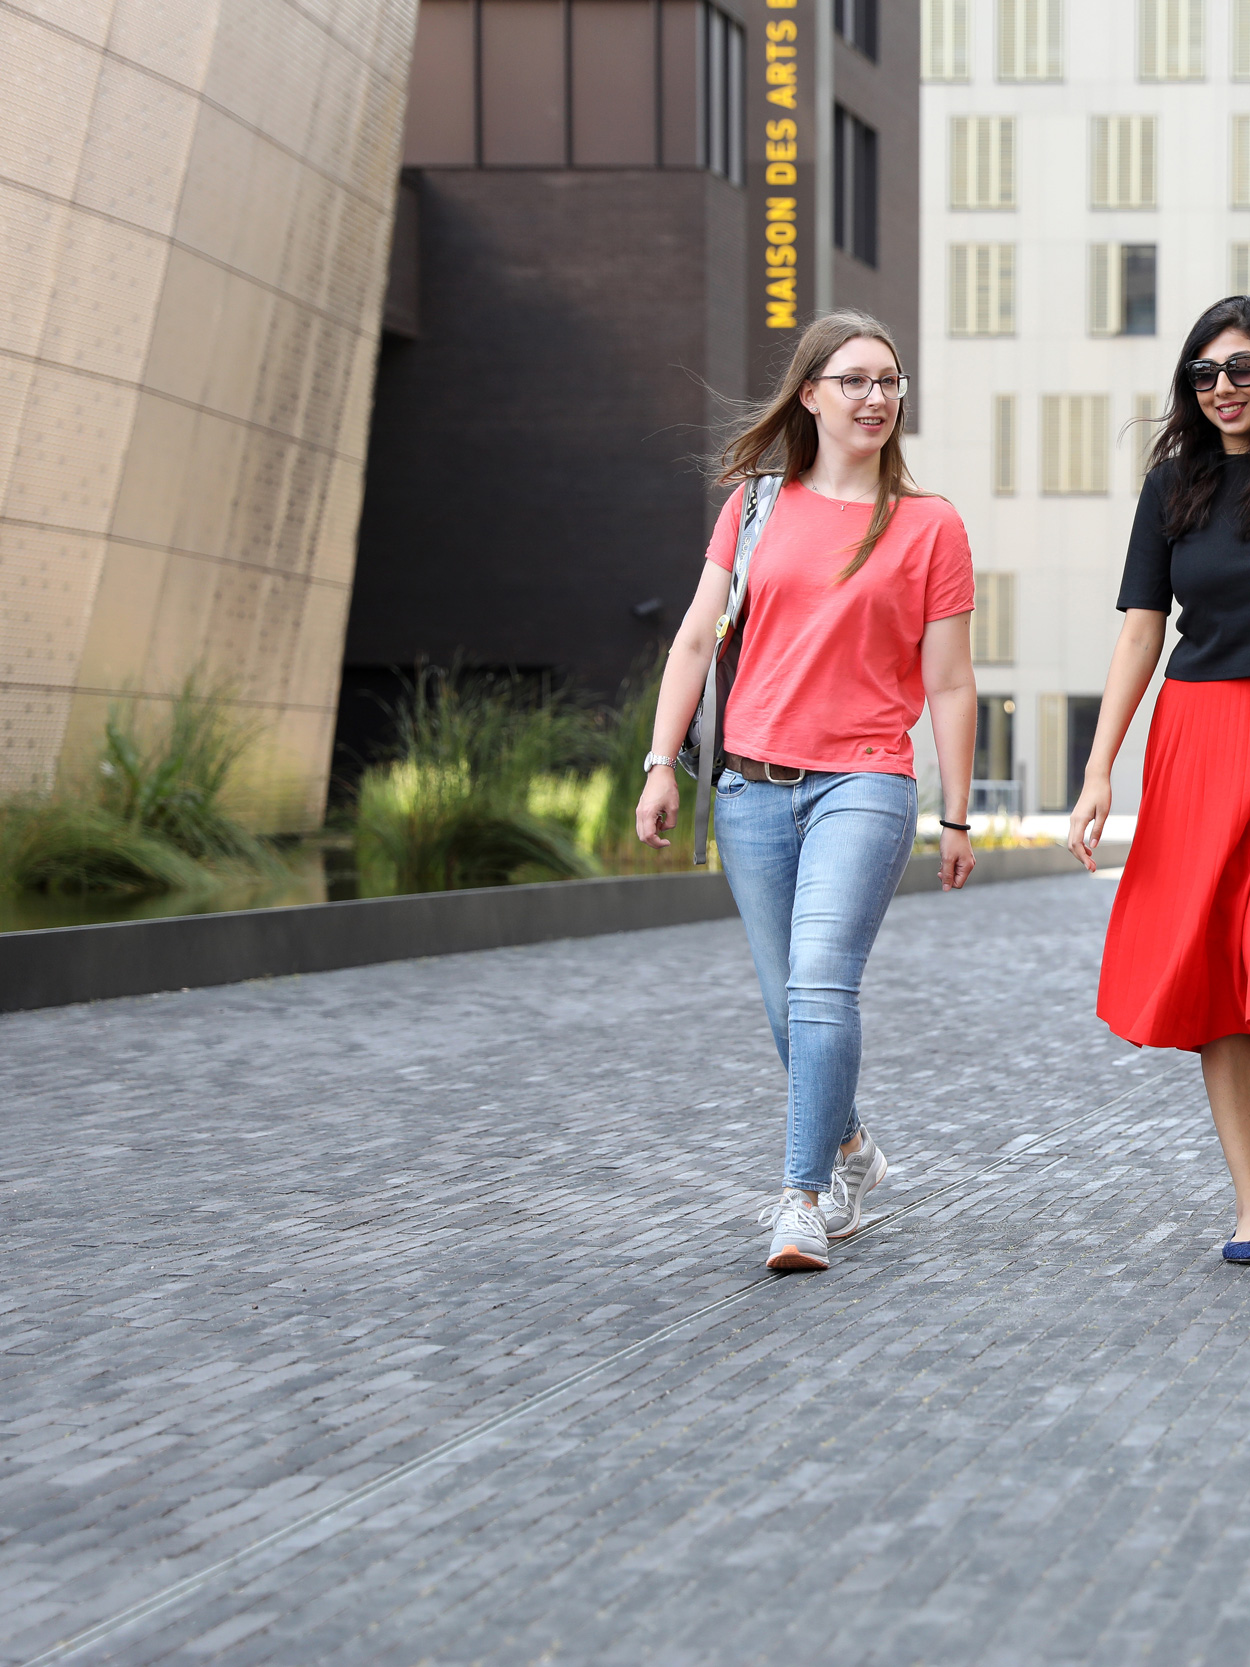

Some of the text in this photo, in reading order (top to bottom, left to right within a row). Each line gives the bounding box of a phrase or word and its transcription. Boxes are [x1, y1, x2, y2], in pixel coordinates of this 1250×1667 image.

[766, 19, 797, 109] ARTS
[766, 118, 797, 186] DES
[766, 197, 797, 328] MAISON
